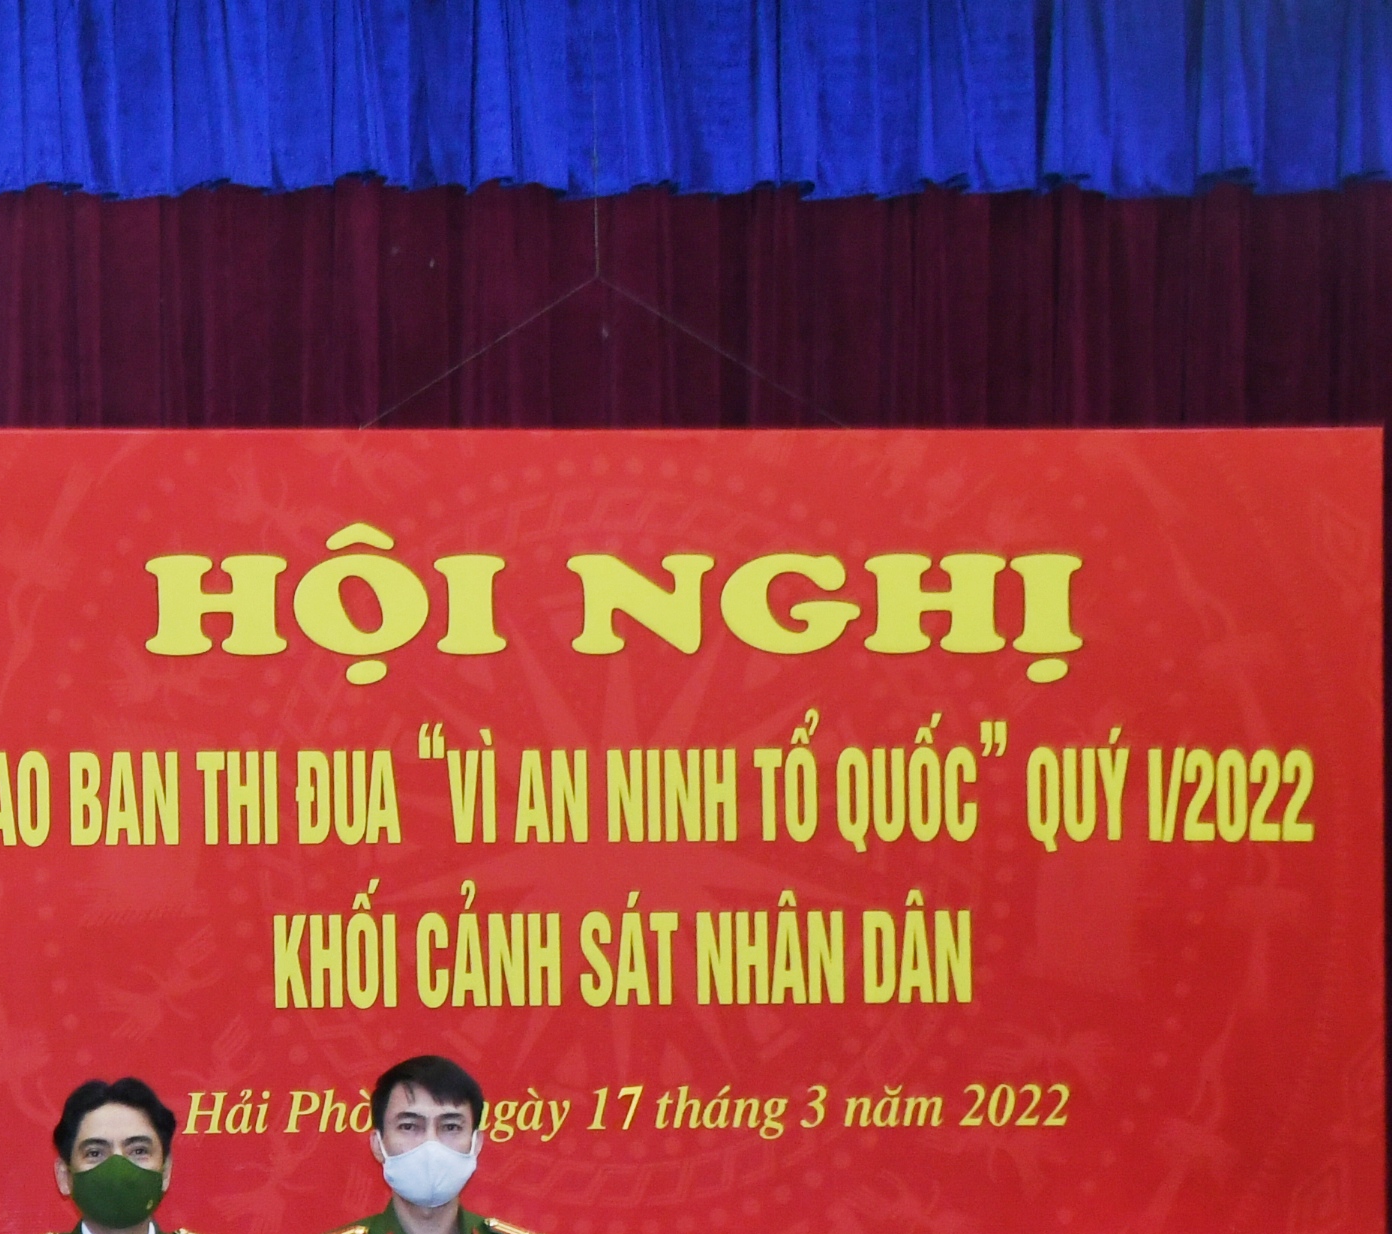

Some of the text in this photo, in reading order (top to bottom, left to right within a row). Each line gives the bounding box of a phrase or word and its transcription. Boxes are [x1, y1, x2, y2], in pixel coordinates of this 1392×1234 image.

[145, 522, 1083, 685] HỘI NGHỊ
[69, 750, 180, 846] BAN
[196, 750, 279, 845] THI
[295, 749, 402, 845] ĐUA
[514, 749, 589, 843] AN
[606, 748, 738, 843] NINH
[753, 708, 819, 843] TỔ
[1026, 727, 1130, 853] QUÝ
[1148, 746, 1315, 843] I/2022
[273, 878, 973, 1009] KHỐI CẢNH SÁT NHÂN DÂN
[183, 1085, 270, 1135] Hải
[283, 1088, 373, 1133] Phò
[587, 1085, 643, 1131] 17
[655, 1085, 789, 1141] tháng
[801, 1085, 827, 1129] 3
[843, 1087, 944, 1128] năm
[959, 1083, 1070, 1127] 2022
